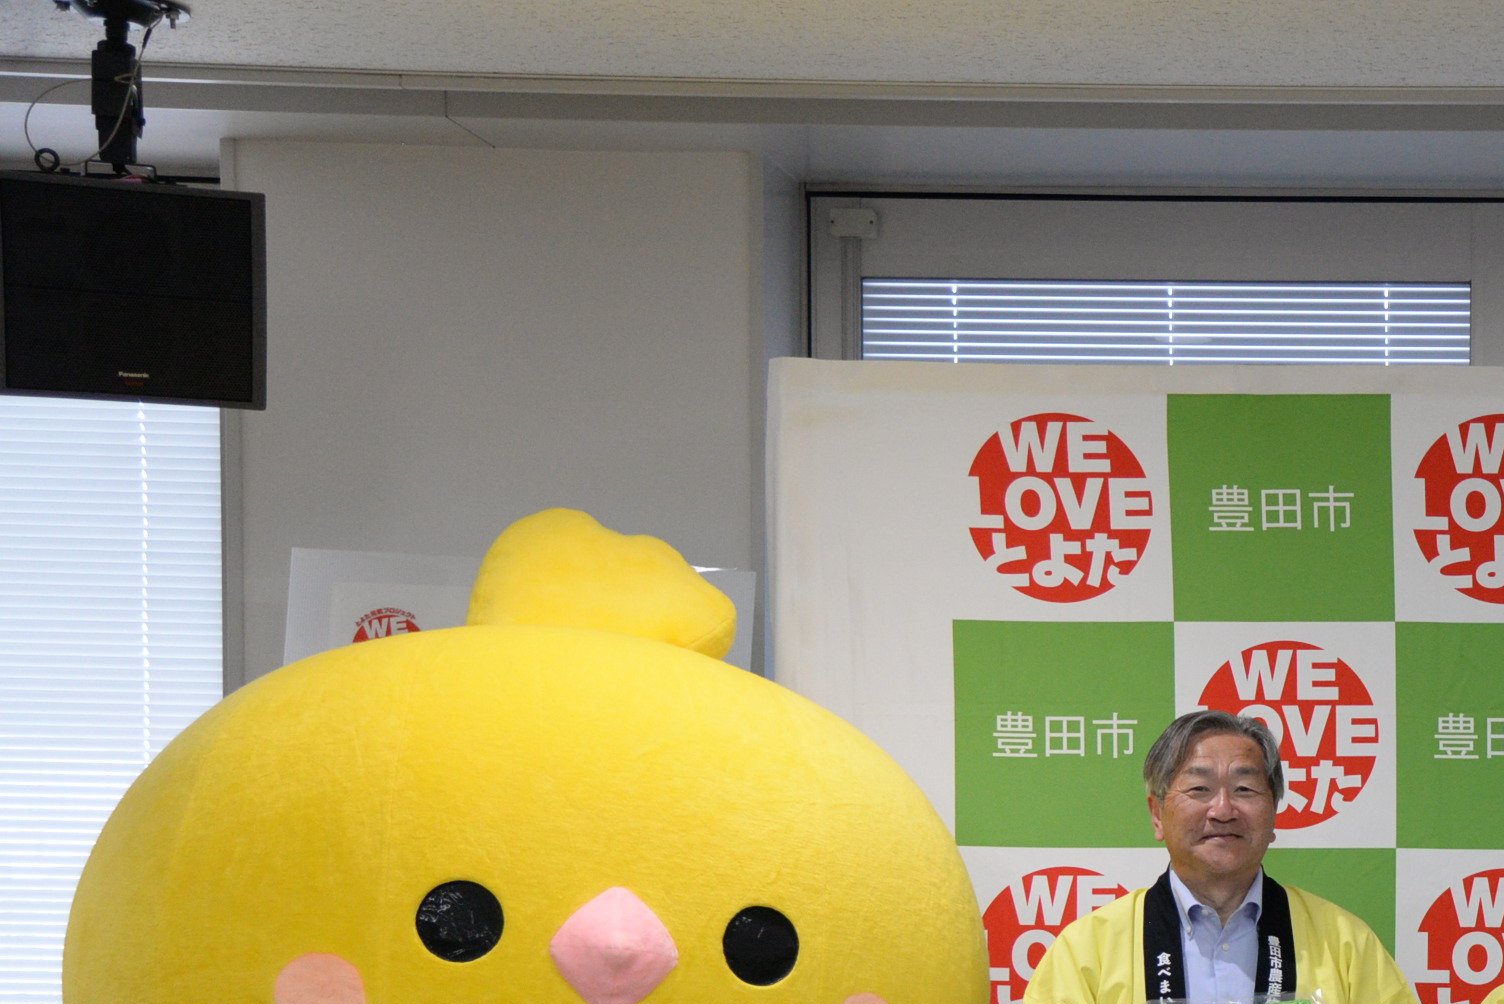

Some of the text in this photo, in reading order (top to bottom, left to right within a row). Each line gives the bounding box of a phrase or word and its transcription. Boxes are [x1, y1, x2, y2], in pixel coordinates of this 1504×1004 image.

[1000, 421, 1111, 474] WE
[967, 477, 1154, 531] LOVE
[1208, 484, 1355, 532] 豊田市
[993, 532, 1138, 589] とよた
[361, 617, 410, 639] WE
[1228, 649, 1340, 701] WE
[991, 711, 1139, 759] 豊田市
[1277, 760, 1362, 815] よた
